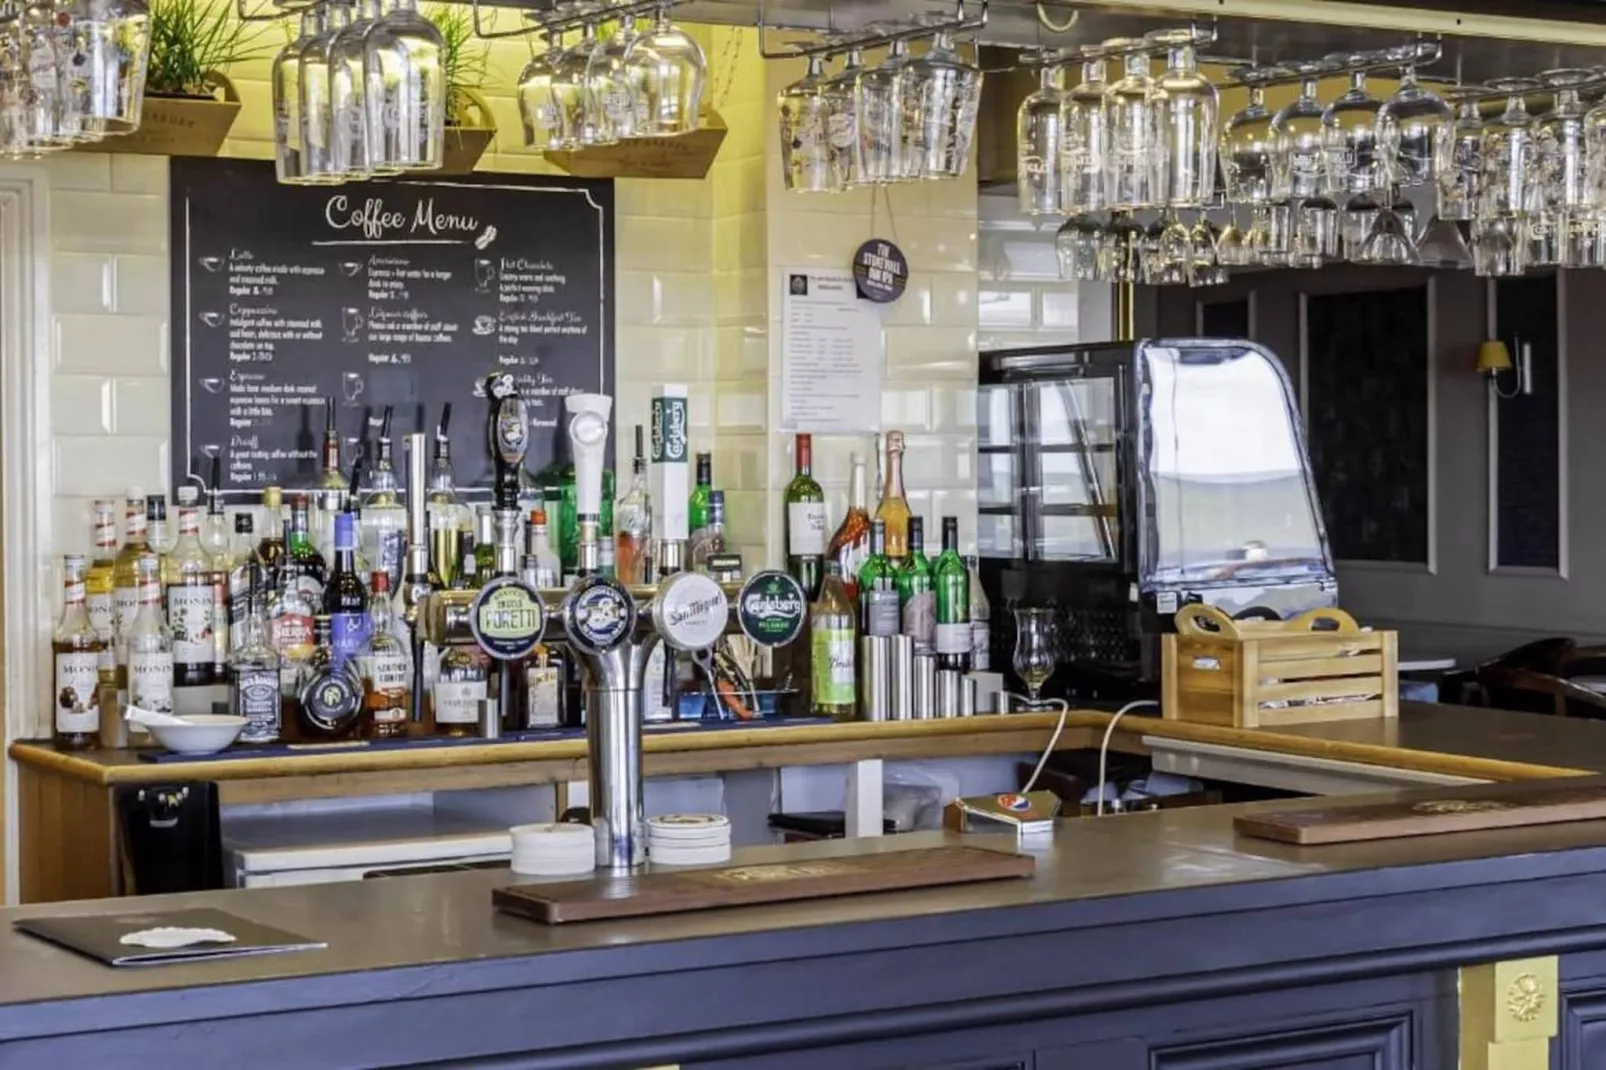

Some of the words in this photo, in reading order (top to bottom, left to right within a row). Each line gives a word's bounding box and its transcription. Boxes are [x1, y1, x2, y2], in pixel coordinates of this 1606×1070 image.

[325, 195, 405, 238] Coffee
[410, 198, 479, 235] Menu
[666, 399, 688, 459] Carlsberg
[670, 608, 691, 626] San
[745, 592, 801, 620] Carlsberg
